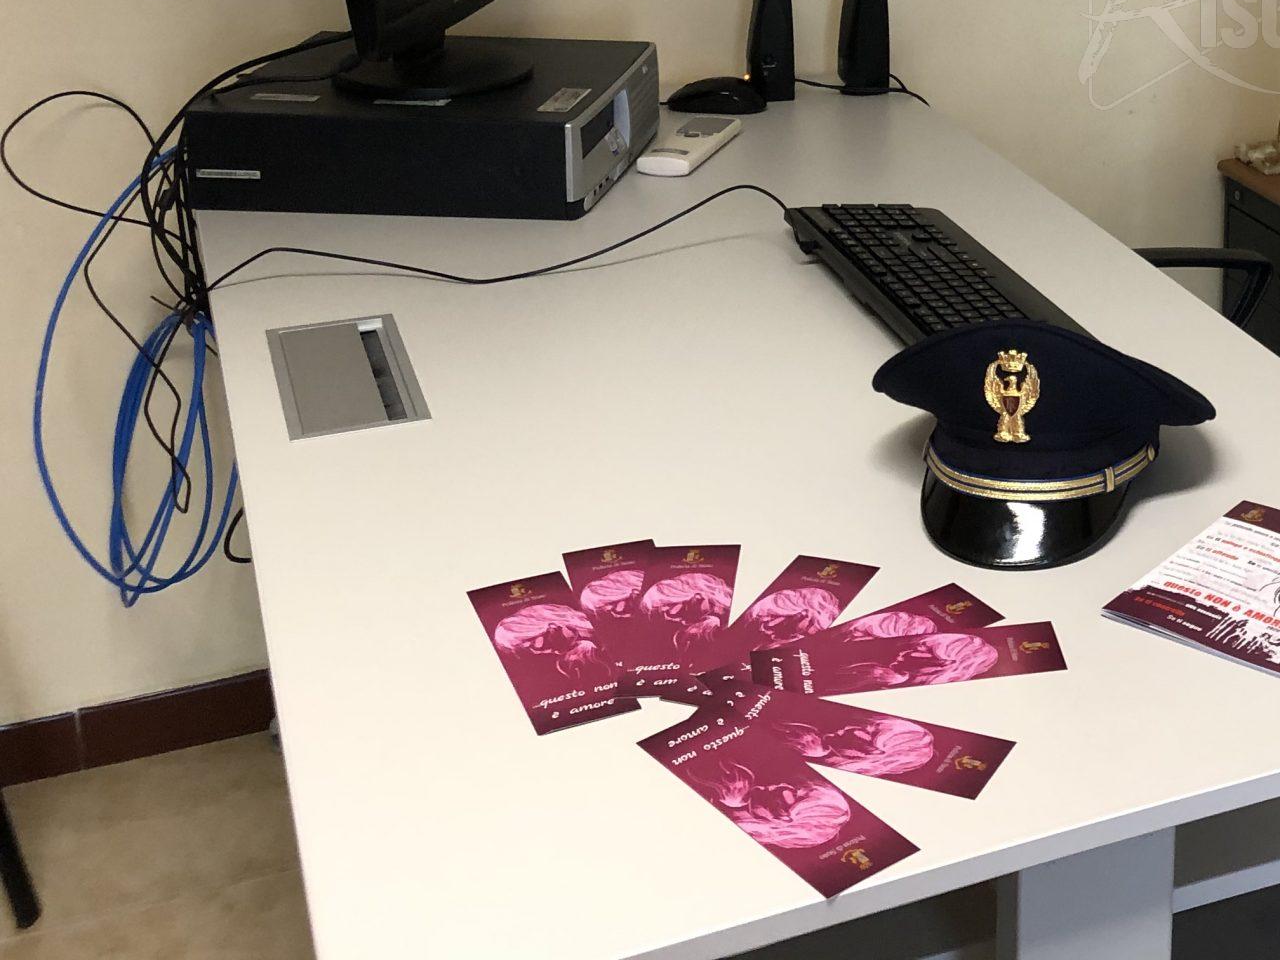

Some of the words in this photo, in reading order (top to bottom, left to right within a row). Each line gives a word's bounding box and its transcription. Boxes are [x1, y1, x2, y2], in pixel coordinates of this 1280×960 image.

[1163, 581, 1201, 597] questo
[1204, 592, 1232, 608] NON
[594, 682, 618, 693] non
[569, 698, 615, 715] amore
[668, 725, 709, 748] amore
[672, 750, 697, 766] non
